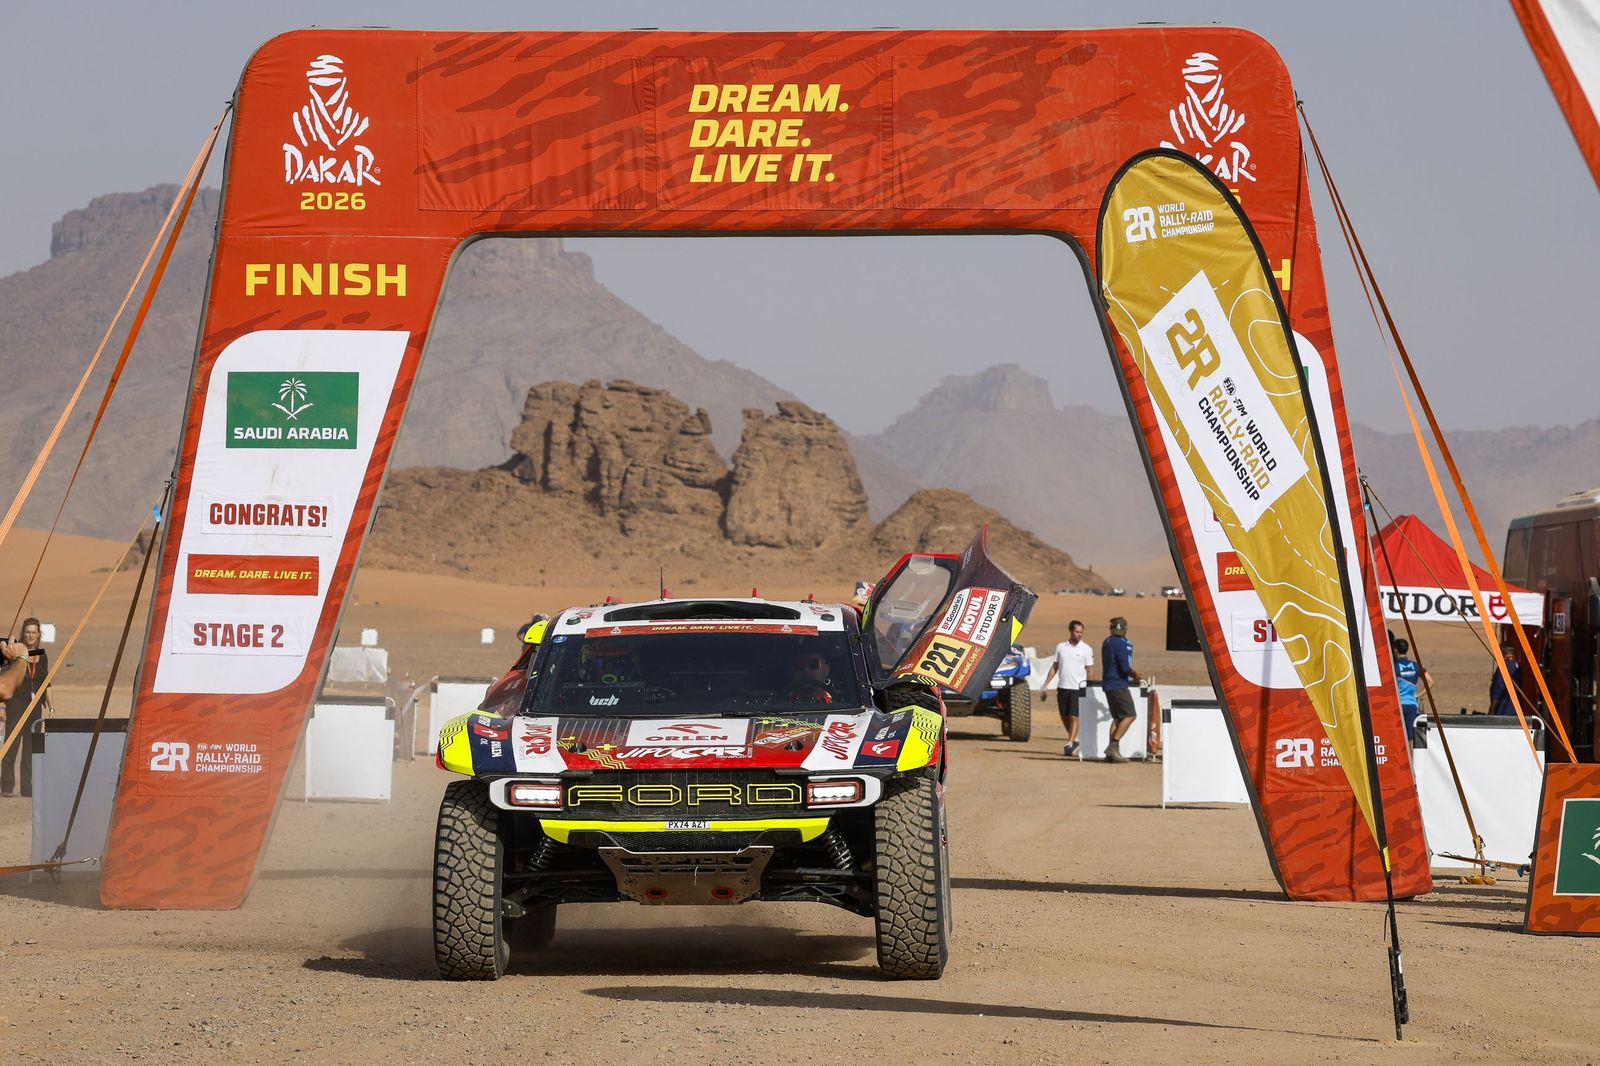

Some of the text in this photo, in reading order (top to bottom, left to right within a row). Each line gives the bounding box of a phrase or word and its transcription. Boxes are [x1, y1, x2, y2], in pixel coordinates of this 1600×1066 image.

[688, 84, 849, 113] DREAM.
[689, 119, 812, 148] DARE.
[282, 142, 381, 187] DAKAR
[690, 154, 836, 183] LIVE IT.
[1160, 140, 1256, 183] KAR
[300, 192, 366, 210] 2026
[1157, 202, 1185, 214] WORLD
[1123, 206, 1157, 243] 2R
[1159, 209, 1214, 227] RALLY-RAID
[1161, 222, 1215, 239] CHAMPIONSHIP
[245, 263, 407, 296] FINISH
[1165, 308, 1222, 391] 2R
[233, 427, 349, 441] SAUDI ARABIA
[1208, 385, 1270, 490] RALLY-RAID
[1223, 377, 1236, 396] FIA
[1246, 419, 1277, 472] WORLD
[1198, 397, 1260, 501] CHAMPIONSHIP
[209, 502, 328, 528] CONGRATS!
[194, 568, 313, 580] DREAM. DARE. LIVE IT.
[941, 593, 963, 630] BFGoodrich
[959, 595, 984, 635] MOTUL
[1381, 592, 1480, 617] UDOR
[979, 603, 998, 637] TUDOR
[193, 623, 284, 648] STAGE 2
[920, 642, 966, 679] 221
[150, 741, 190, 772] 2R
[196, 752, 261, 764] RALLY-RAID
[225, 743, 257, 752] WORLD
[616, 746, 747, 759] JIPOCAR
[1275, 738, 1315, 768] 2R
[195, 764, 262, 773] CHAMPIONSHIP
[568, 783, 802, 806] FORD
[668, 821, 708, 829] PX74 AZT
